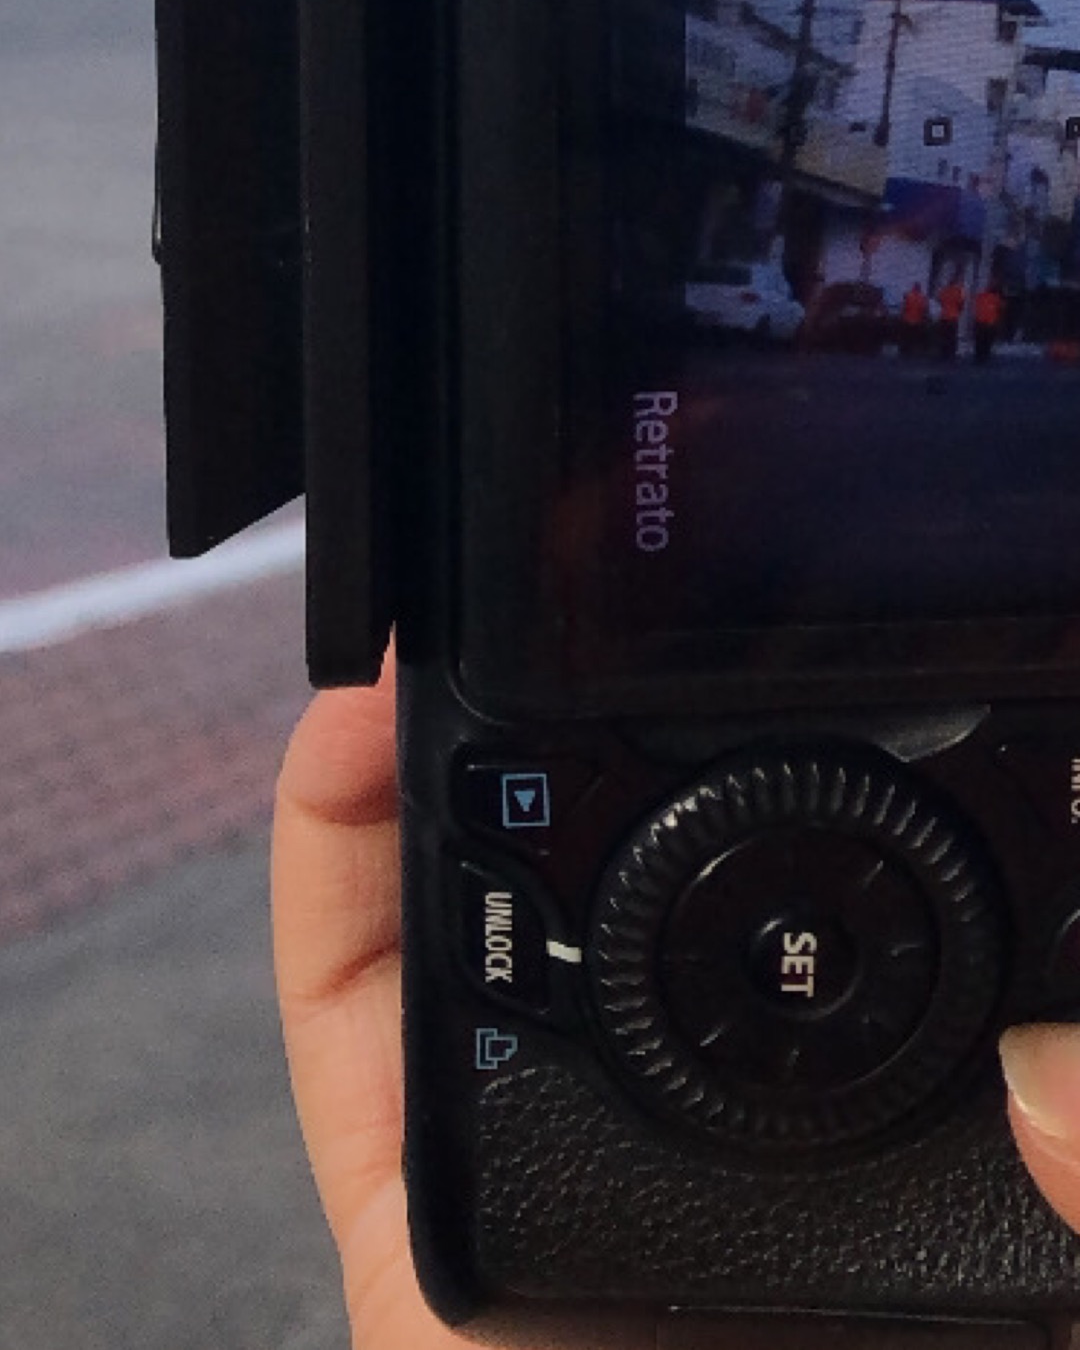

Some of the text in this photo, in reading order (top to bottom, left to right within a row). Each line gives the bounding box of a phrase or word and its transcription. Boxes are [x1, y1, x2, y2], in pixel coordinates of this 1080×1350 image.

[632, 390, 679, 552] Retrato
[484, 891, 513, 983] UNLOCK
[780, 931, 818, 998] SET
